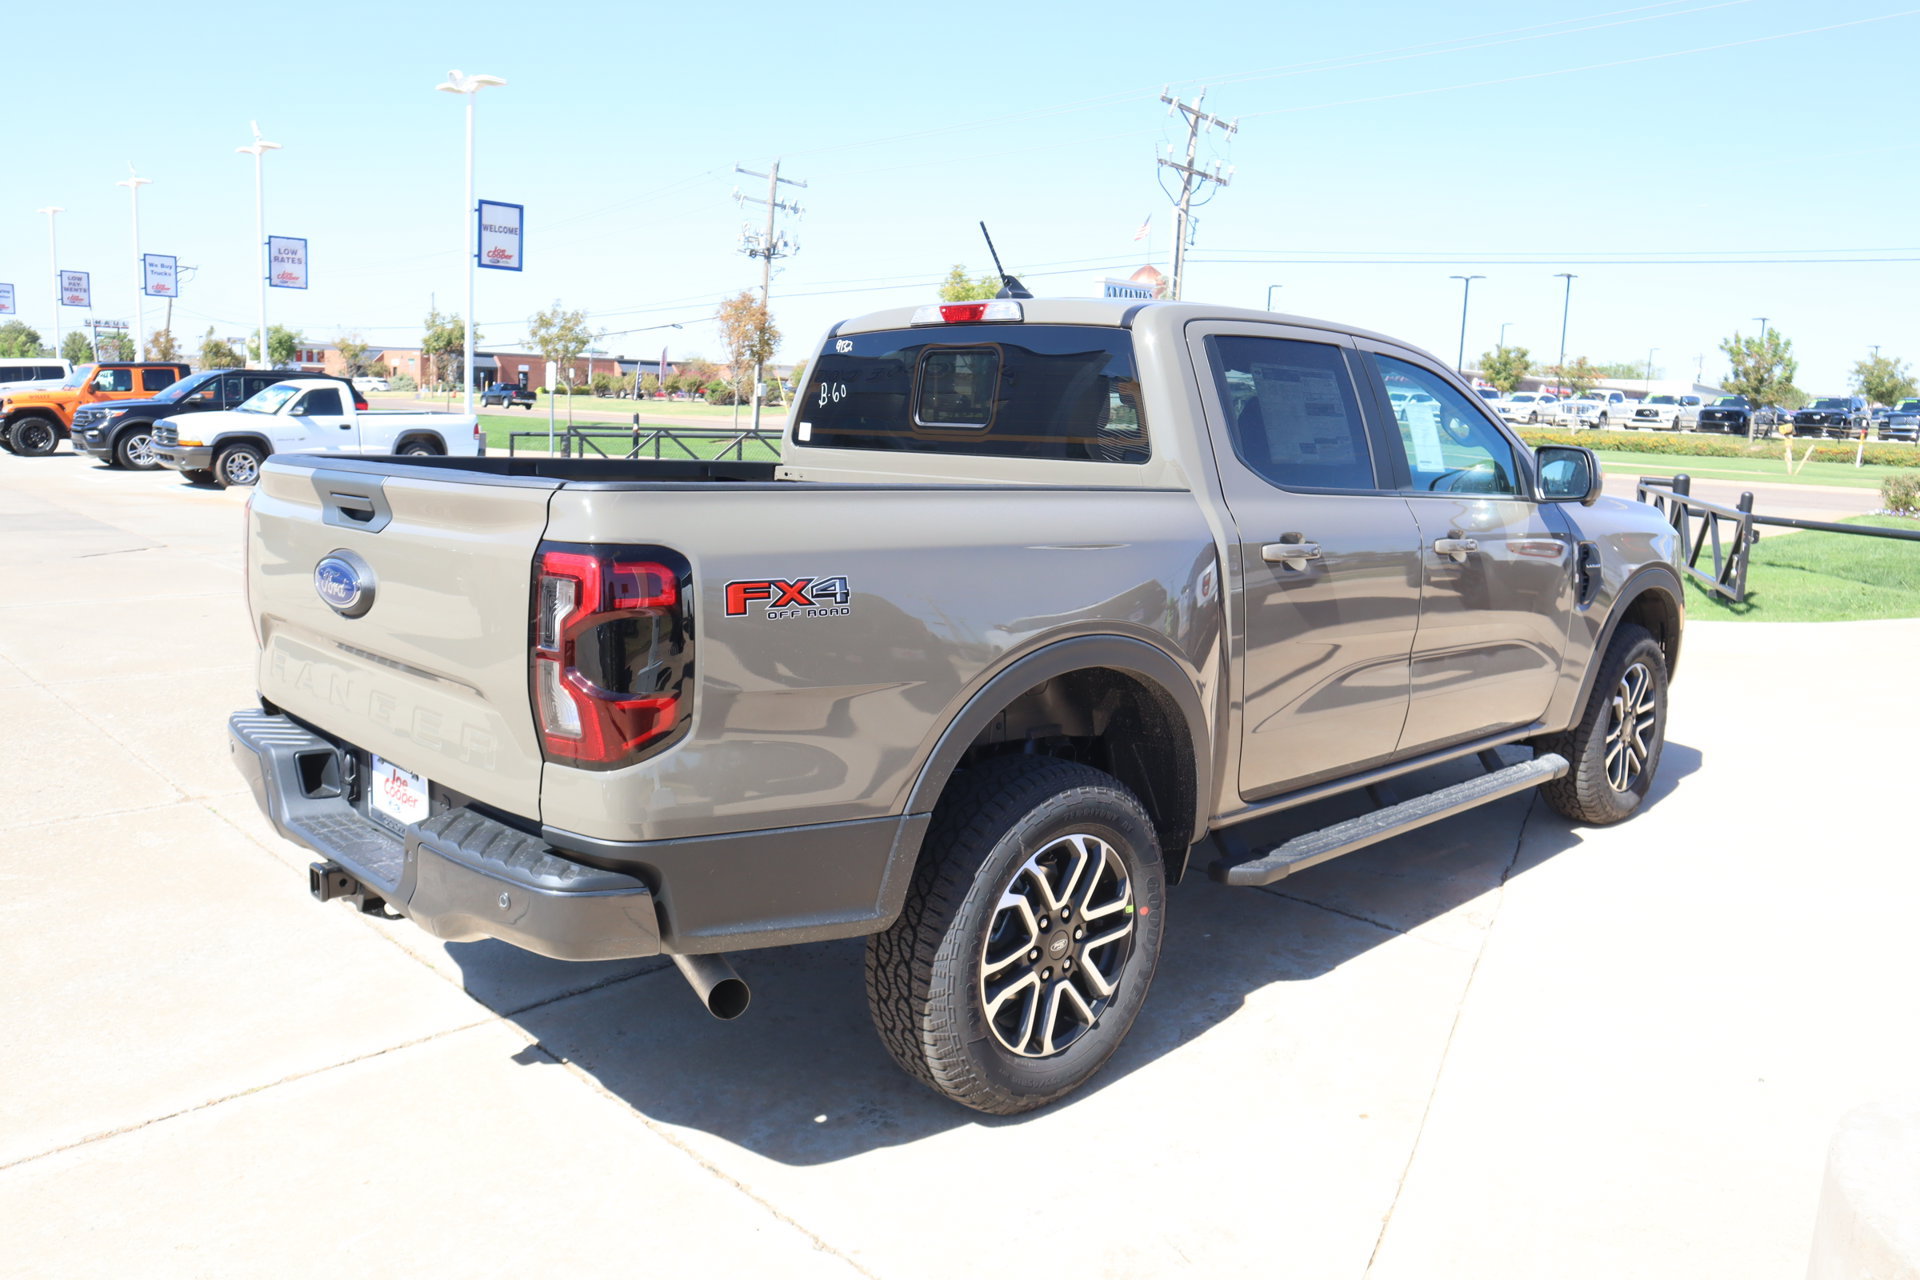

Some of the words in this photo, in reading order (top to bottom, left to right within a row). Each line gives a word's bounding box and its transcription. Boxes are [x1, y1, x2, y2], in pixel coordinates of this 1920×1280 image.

[482, 223, 519, 236] WELCOME
[278, 247, 298, 256] LOW
[273, 255, 303, 265] RATES
[150, 269, 172, 277] Trucks
[160, 263, 173, 271] Buy
[724, 575, 851, 618] FX4
[766, 610, 801, 620] OFF
[807, 607, 850, 618] ROAD
[269, 648, 497, 770] RANGER
[391, 767, 409, 787] Joe
[383, 777, 418, 808] Cooper
